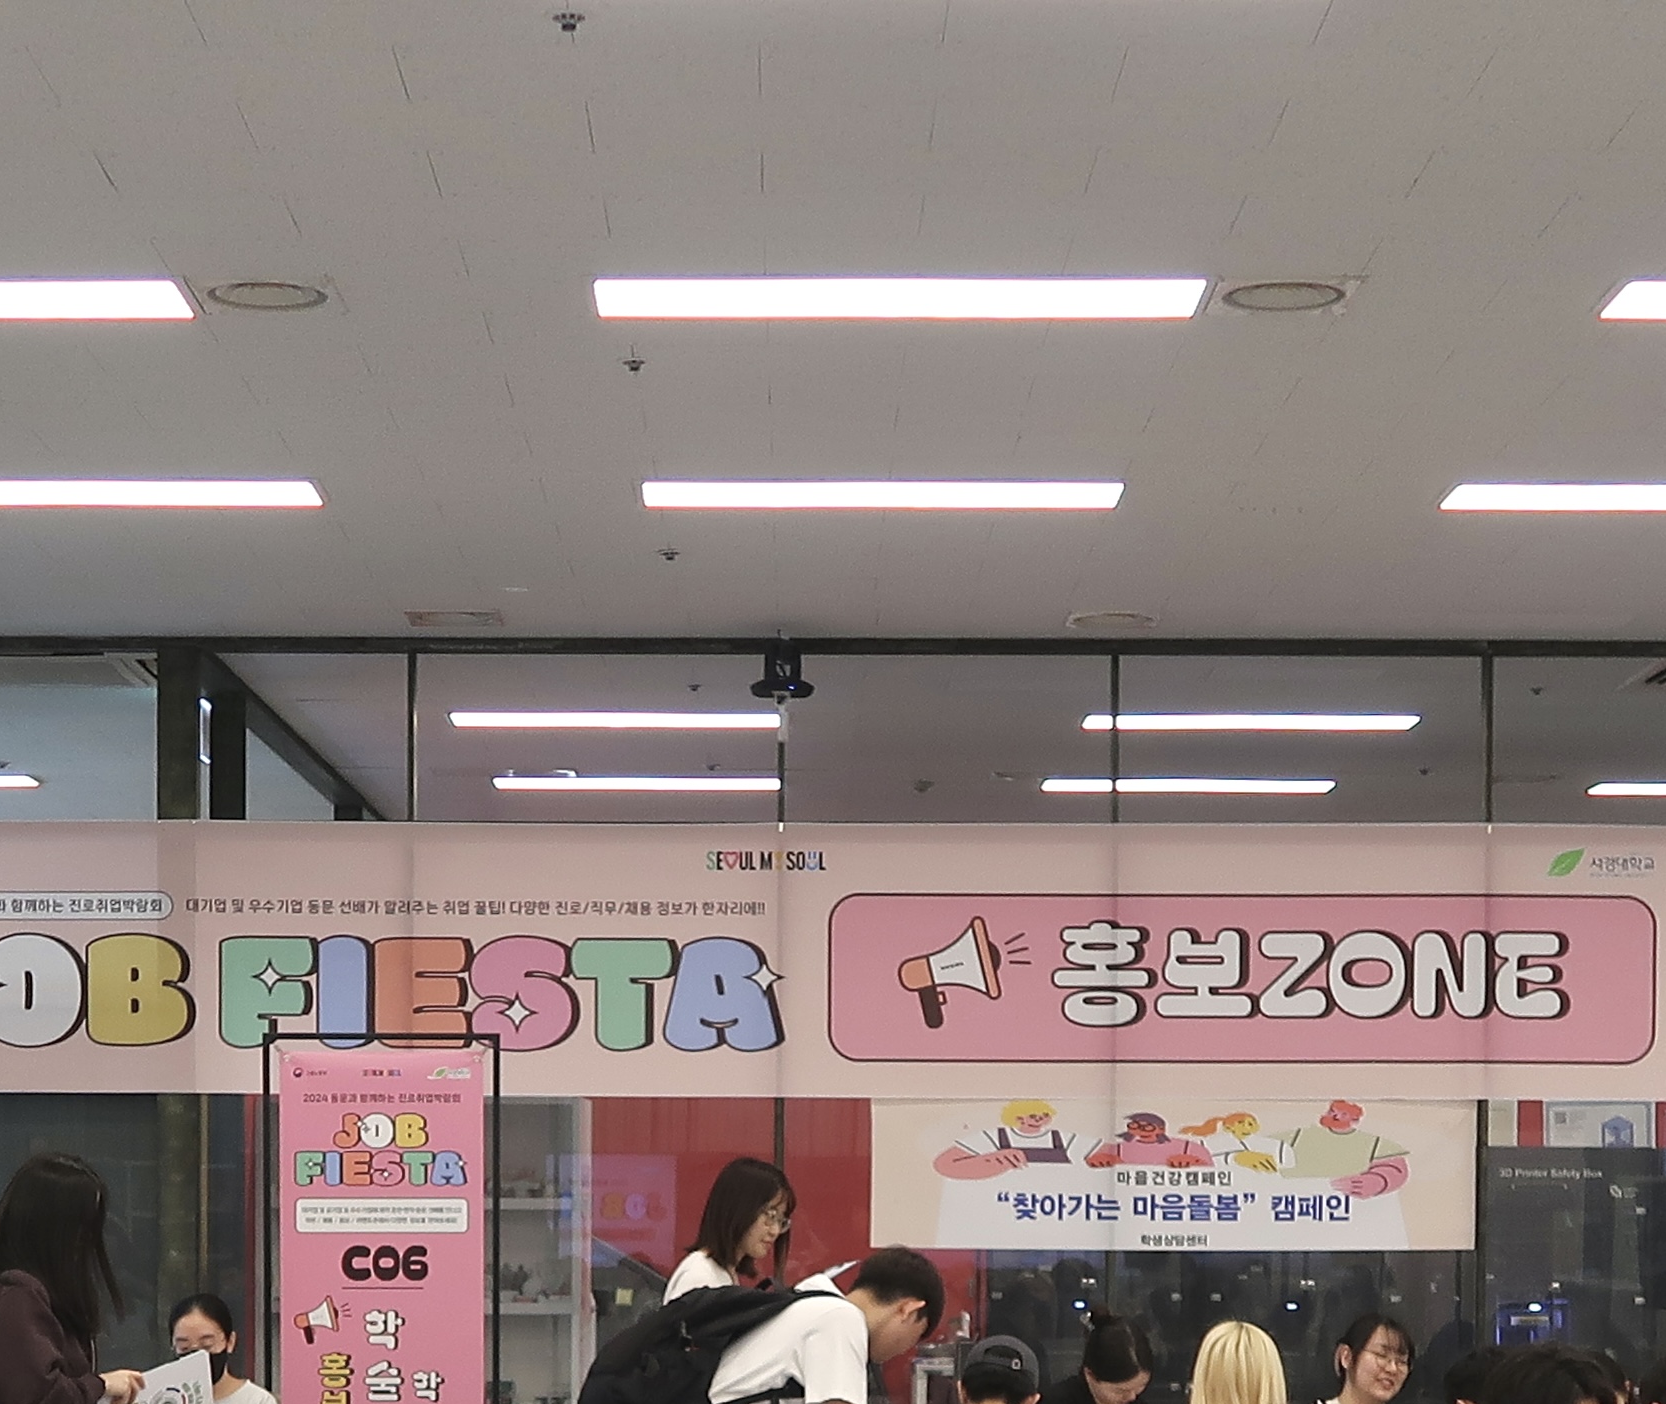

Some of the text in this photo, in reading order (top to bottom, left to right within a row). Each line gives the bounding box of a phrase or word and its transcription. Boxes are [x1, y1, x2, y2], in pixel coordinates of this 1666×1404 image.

[1590, 857, 1655, 872] 서경대학교
[11, 898, 63, 913] 함께하는
[69, 898, 163, 913] 진로취업박람회
[185, 898, 226, 913] 대기업
[231, 898, 244, 914] 및
[248, 899, 303, 914] 우수기업
[307, 899, 334, 914] 동문
[339, 900, 381, 915] 선배가
[443, 900, 470, 915] 취업
[510, 901, 550, 916] 다양한
[555, 901, 651, 917] 진로/직무/채용
[658, 901, 698, 917] 정보가
[702, 901, 766, 917] 한자리에!!
[1052, 920, 1570, 1029] 홍보ZONE
[218, 933, 785, 1053] FIESTA
[302, 1093, 329, 1104] 2024
[333, 1112, 429, 1149] JOB
[293, 1150, 468, 1188] FIESTA
[1515, 1167, 1548, 1178] Printer
[1583, 1167, 1603, 1179] Box
[1116, 1170, 1233, 1187] 마음건강캠페인
[1270, 1194, 1351, 1222] 캠페인
[1140, 1233, 1208, 1247] 학생상담센터
